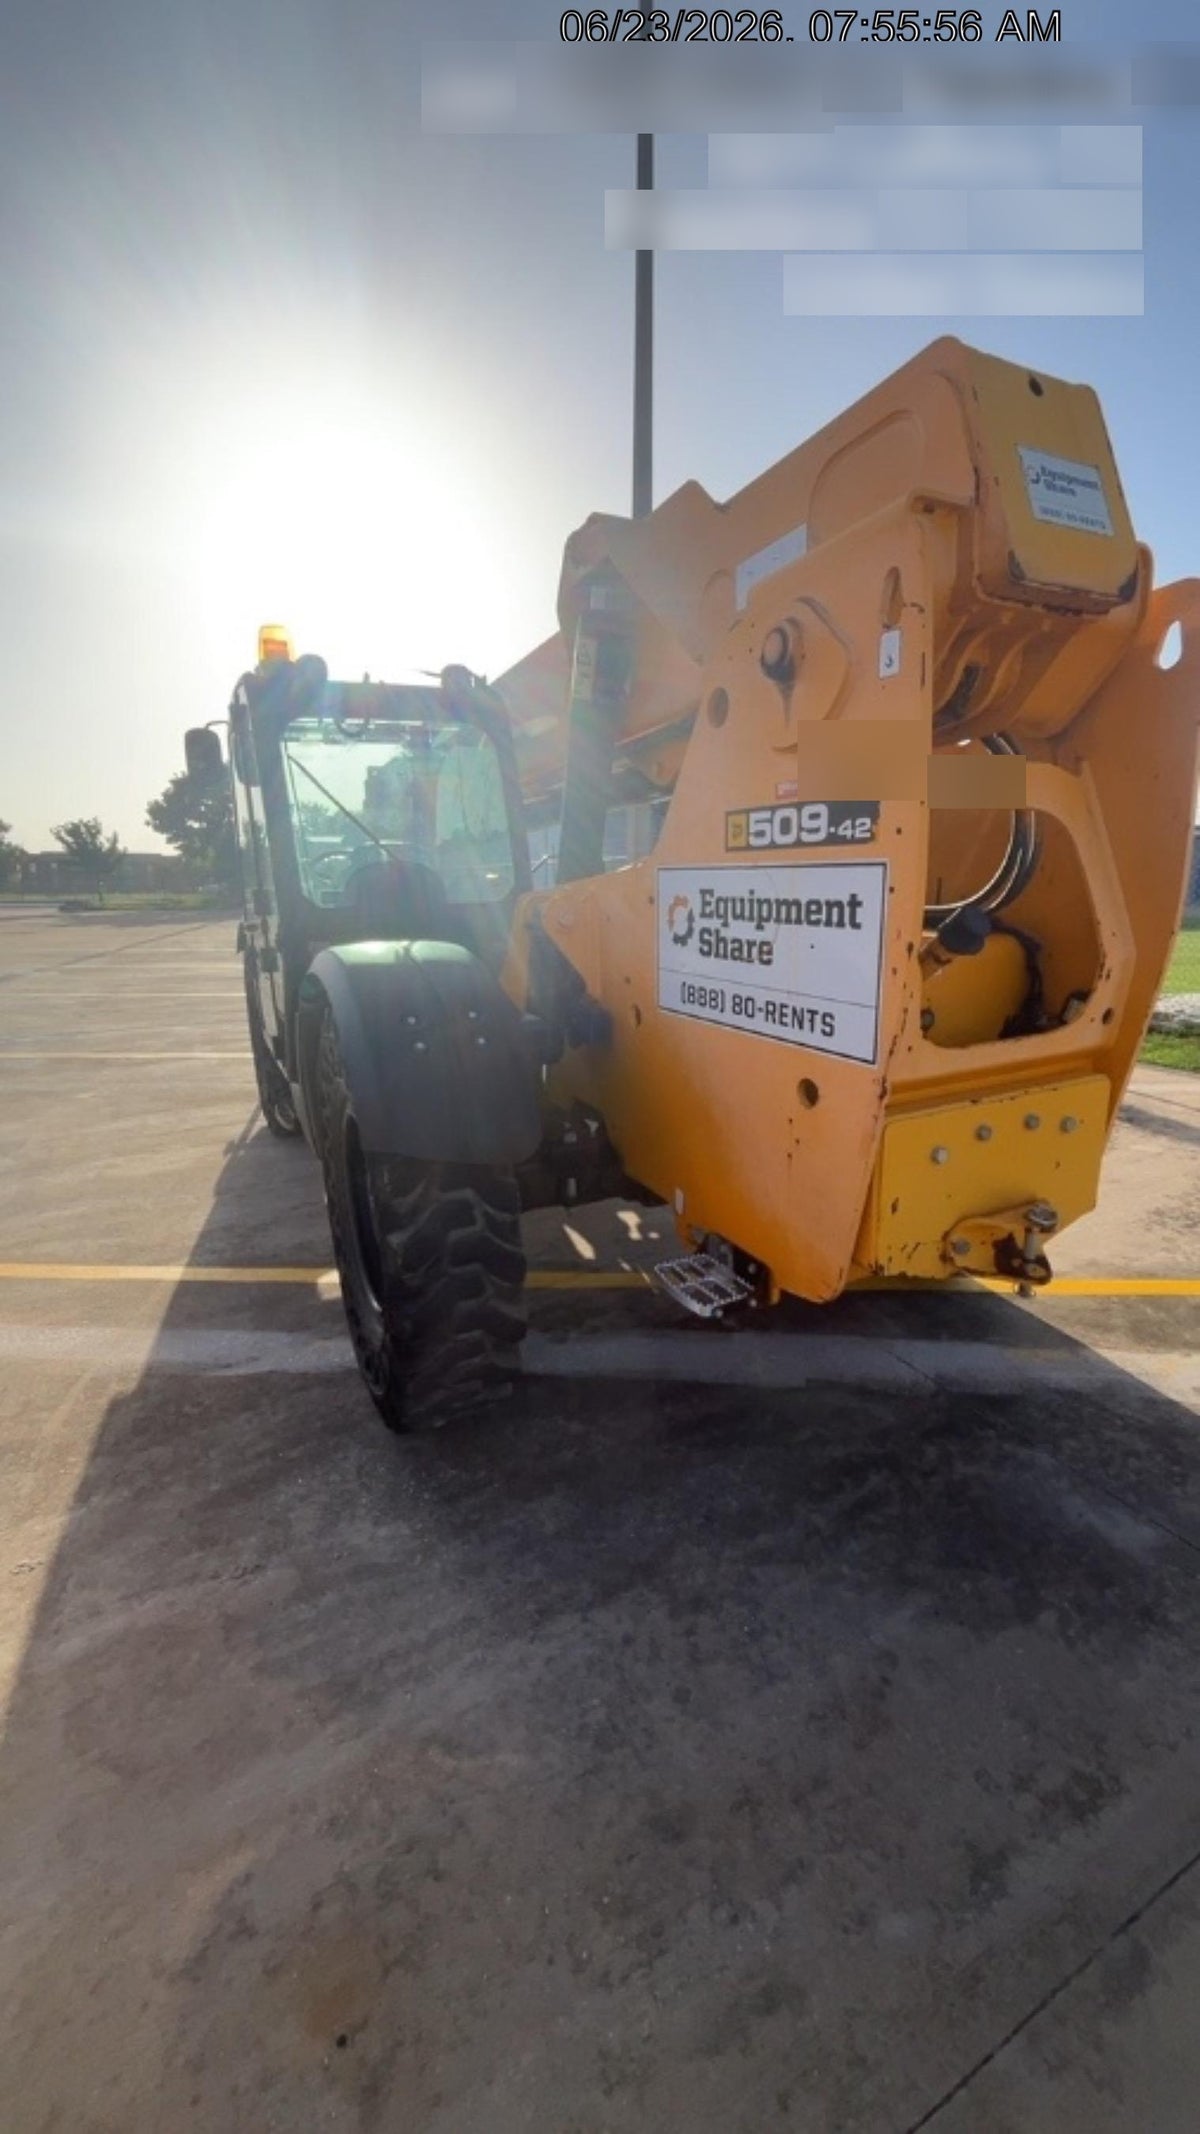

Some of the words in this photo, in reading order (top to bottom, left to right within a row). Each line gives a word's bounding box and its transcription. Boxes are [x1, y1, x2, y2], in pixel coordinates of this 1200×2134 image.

[699, 889, 863, 930] Equipment
[699, 928, 774, 966] Share
[680, 981, 726, 1014] (888)
[731, 996, 836, 1038] 80-RENTS
